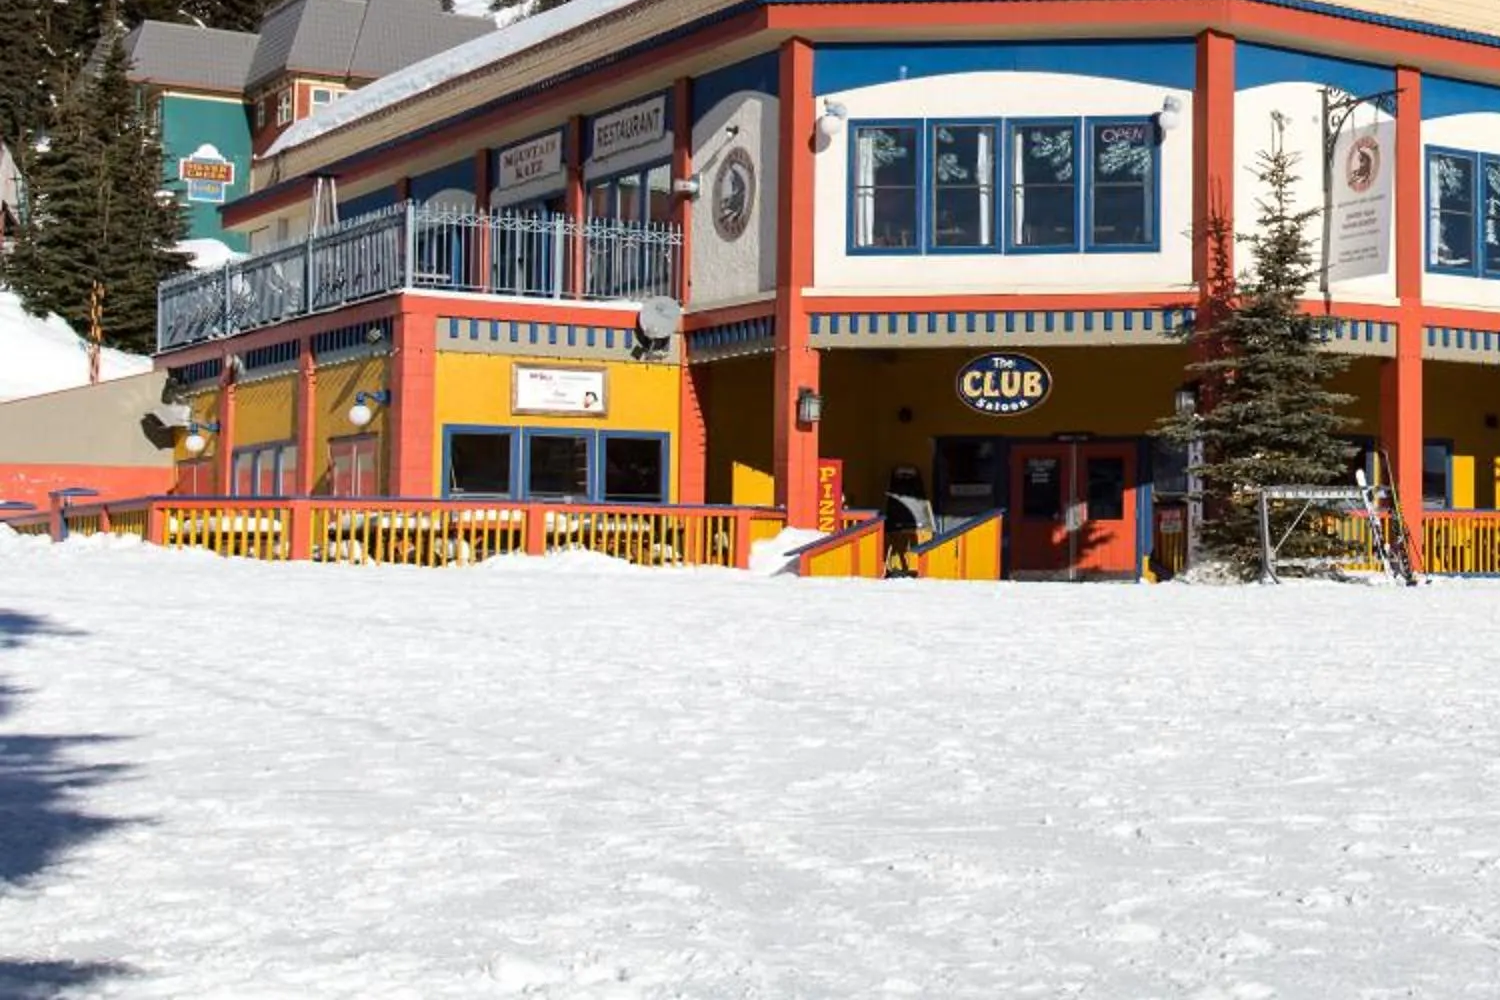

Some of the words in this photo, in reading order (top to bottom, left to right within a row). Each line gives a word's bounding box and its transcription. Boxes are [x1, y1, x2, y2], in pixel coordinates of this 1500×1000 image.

[597, 106, 661, 146] RESTAURANT
[992, 357, 1015, 369] The
[963, 371, 1043, 398] CLUB
[975, 398, 1029, 411] Saloon
[819, 466, 836, 533] PIZZ
